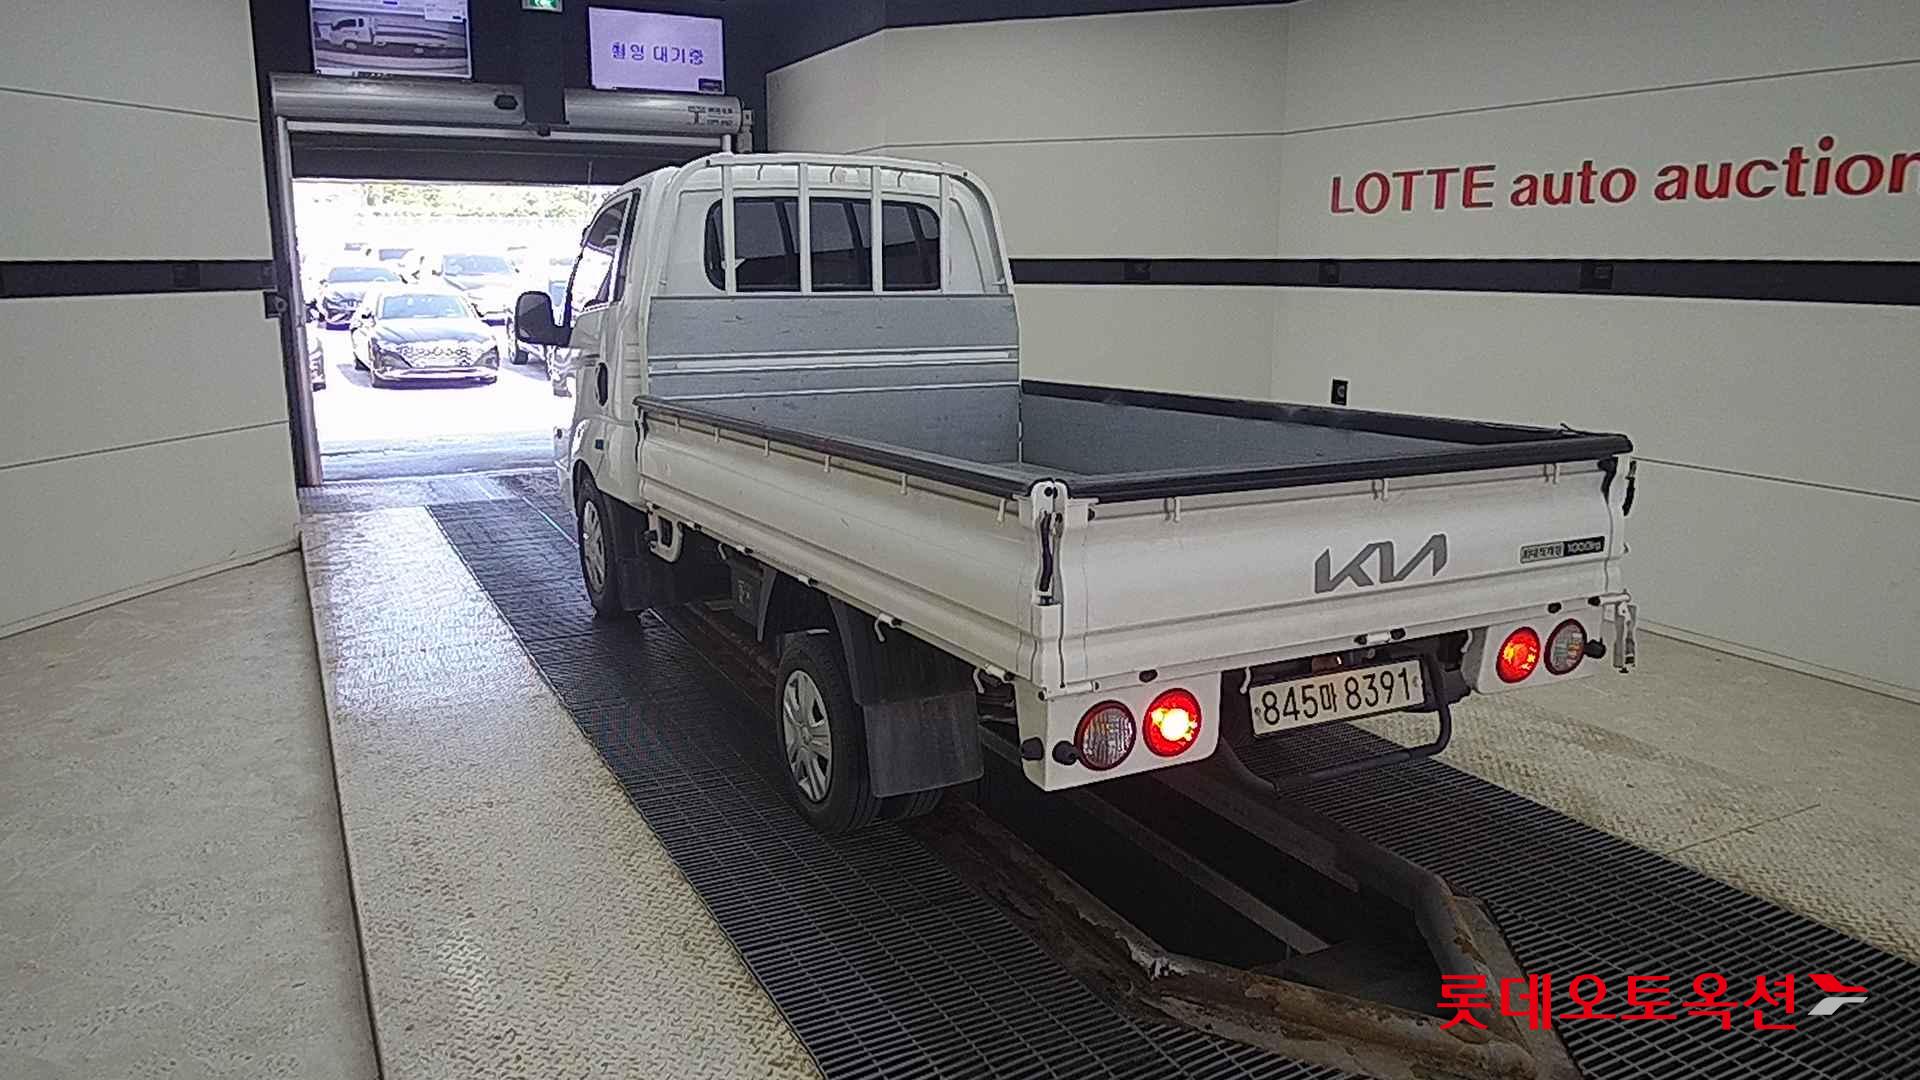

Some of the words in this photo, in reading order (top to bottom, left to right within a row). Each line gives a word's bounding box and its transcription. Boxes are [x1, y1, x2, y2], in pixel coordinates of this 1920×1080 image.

[1331, 165, 1496, 215] LOTTE
[1510, 160, 1638, 207] auto
[1315, 533, 1447, 594] KIA
[1261, 682, 1338, 726] 845마
[1344, 667, 1411, 711] 8391
